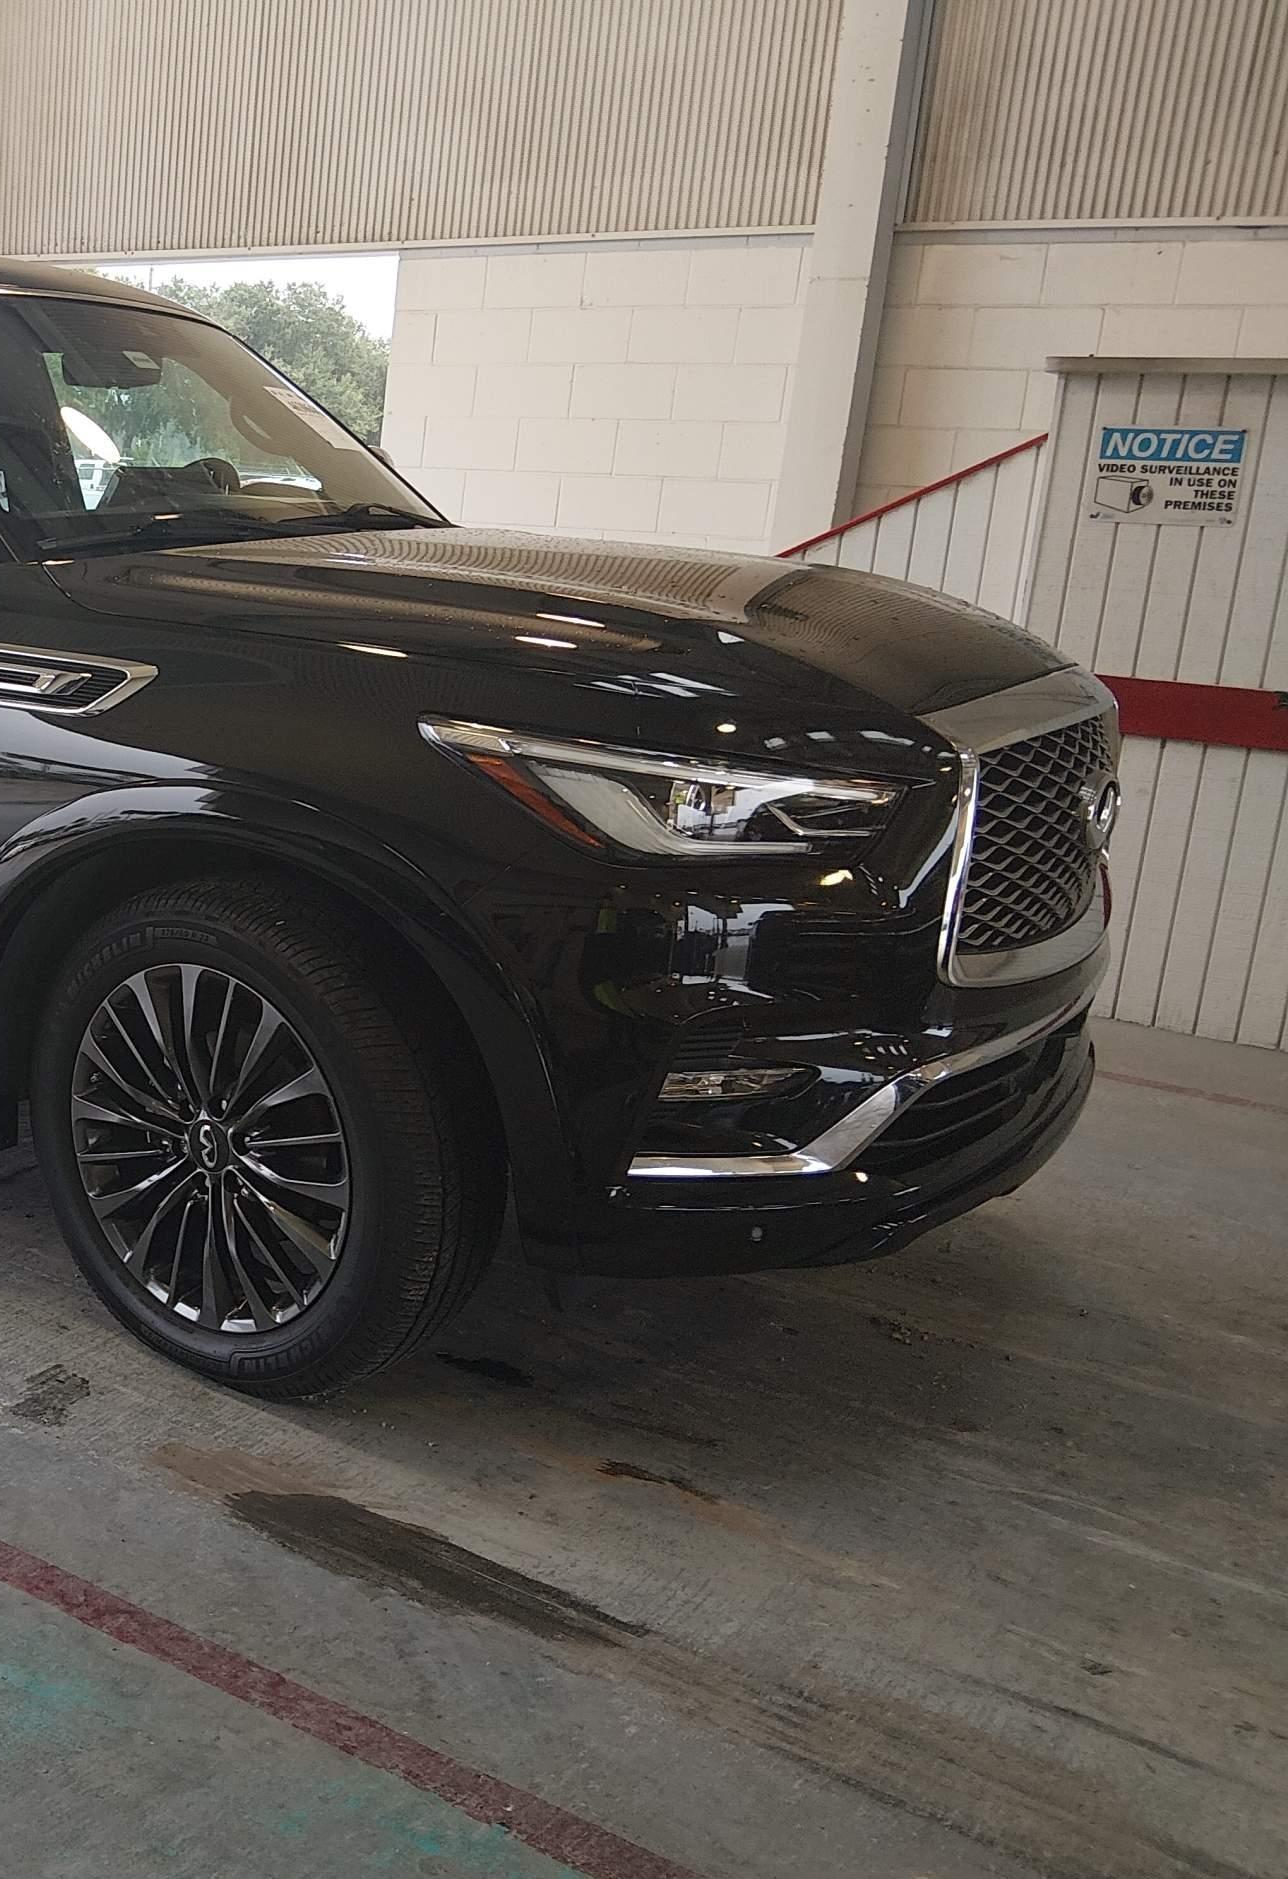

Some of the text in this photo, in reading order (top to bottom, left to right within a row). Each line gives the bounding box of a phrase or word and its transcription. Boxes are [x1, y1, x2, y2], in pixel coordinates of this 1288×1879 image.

[1106, 433, 1239, 459] NOTICE
[1098, 463, 1239, 476] VIDEO SURVEILLANCE
[1169, 477, 1237, 488] IN USE ON
[1193, 489, 1236, 500] THESE
[1164, 501, 1233, 512] PREMISES
